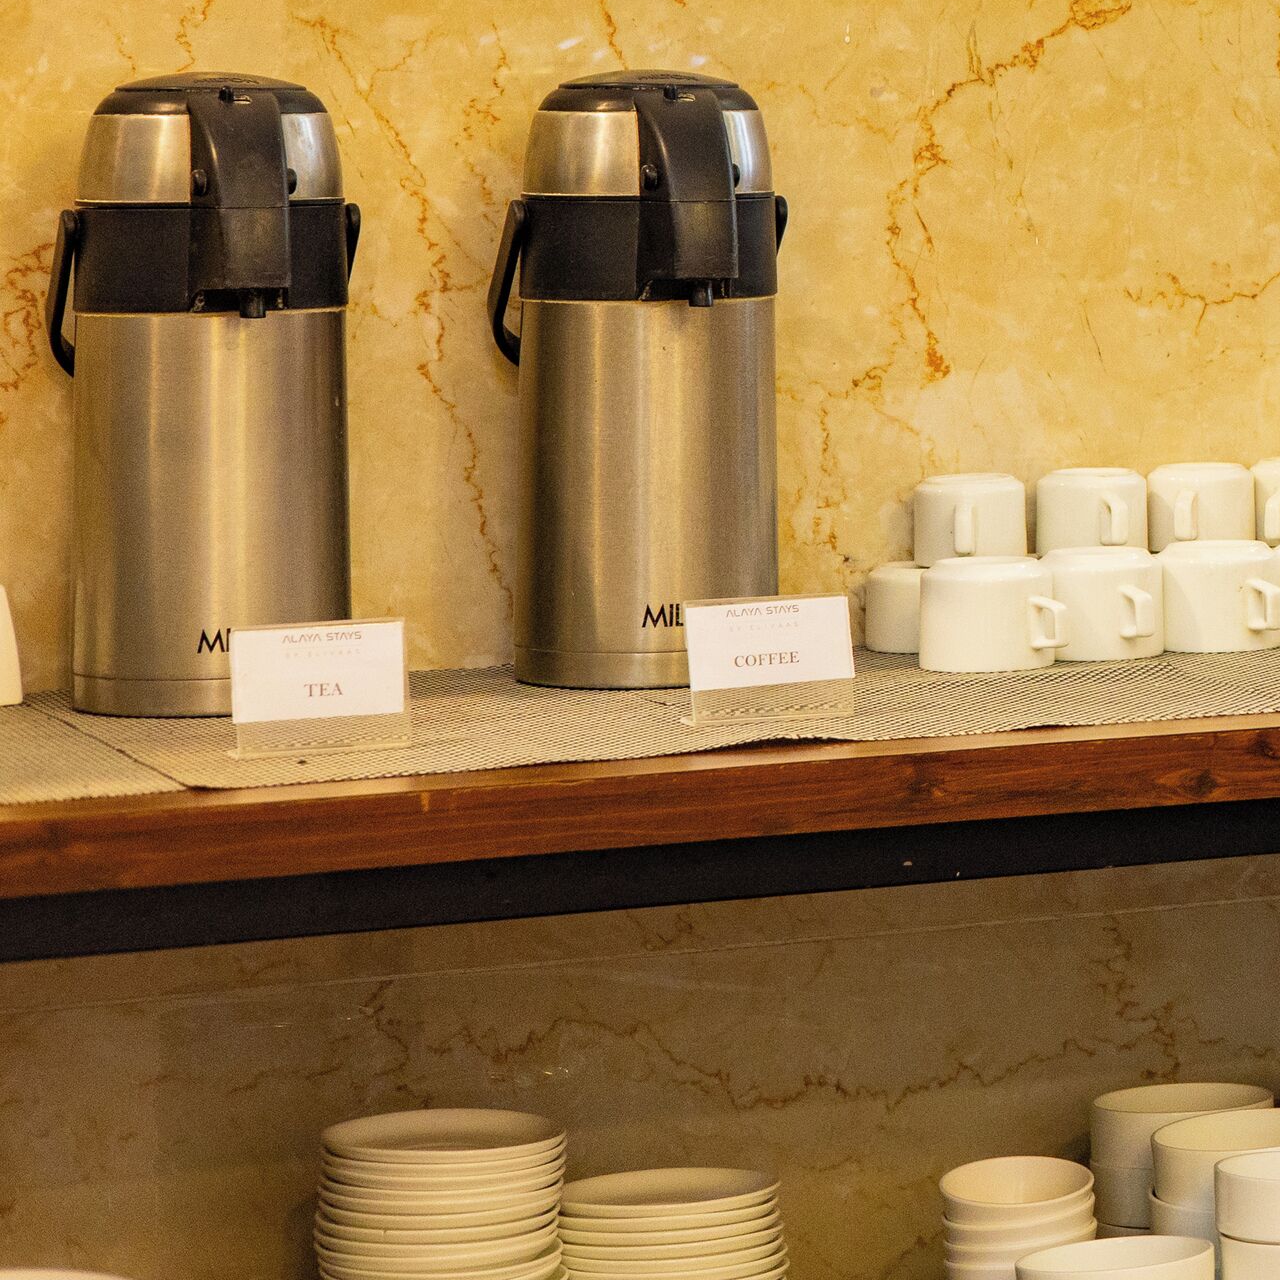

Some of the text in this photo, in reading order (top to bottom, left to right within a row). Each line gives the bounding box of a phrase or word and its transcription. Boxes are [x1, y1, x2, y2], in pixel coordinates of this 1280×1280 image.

[726, 604, 800, 618] ALAYA STAYS
[282, 630, 362, 644] ALAYA STAYS
[734, 650, 800, 668] COFFEE
[304, 682, 343, 698] TEA
